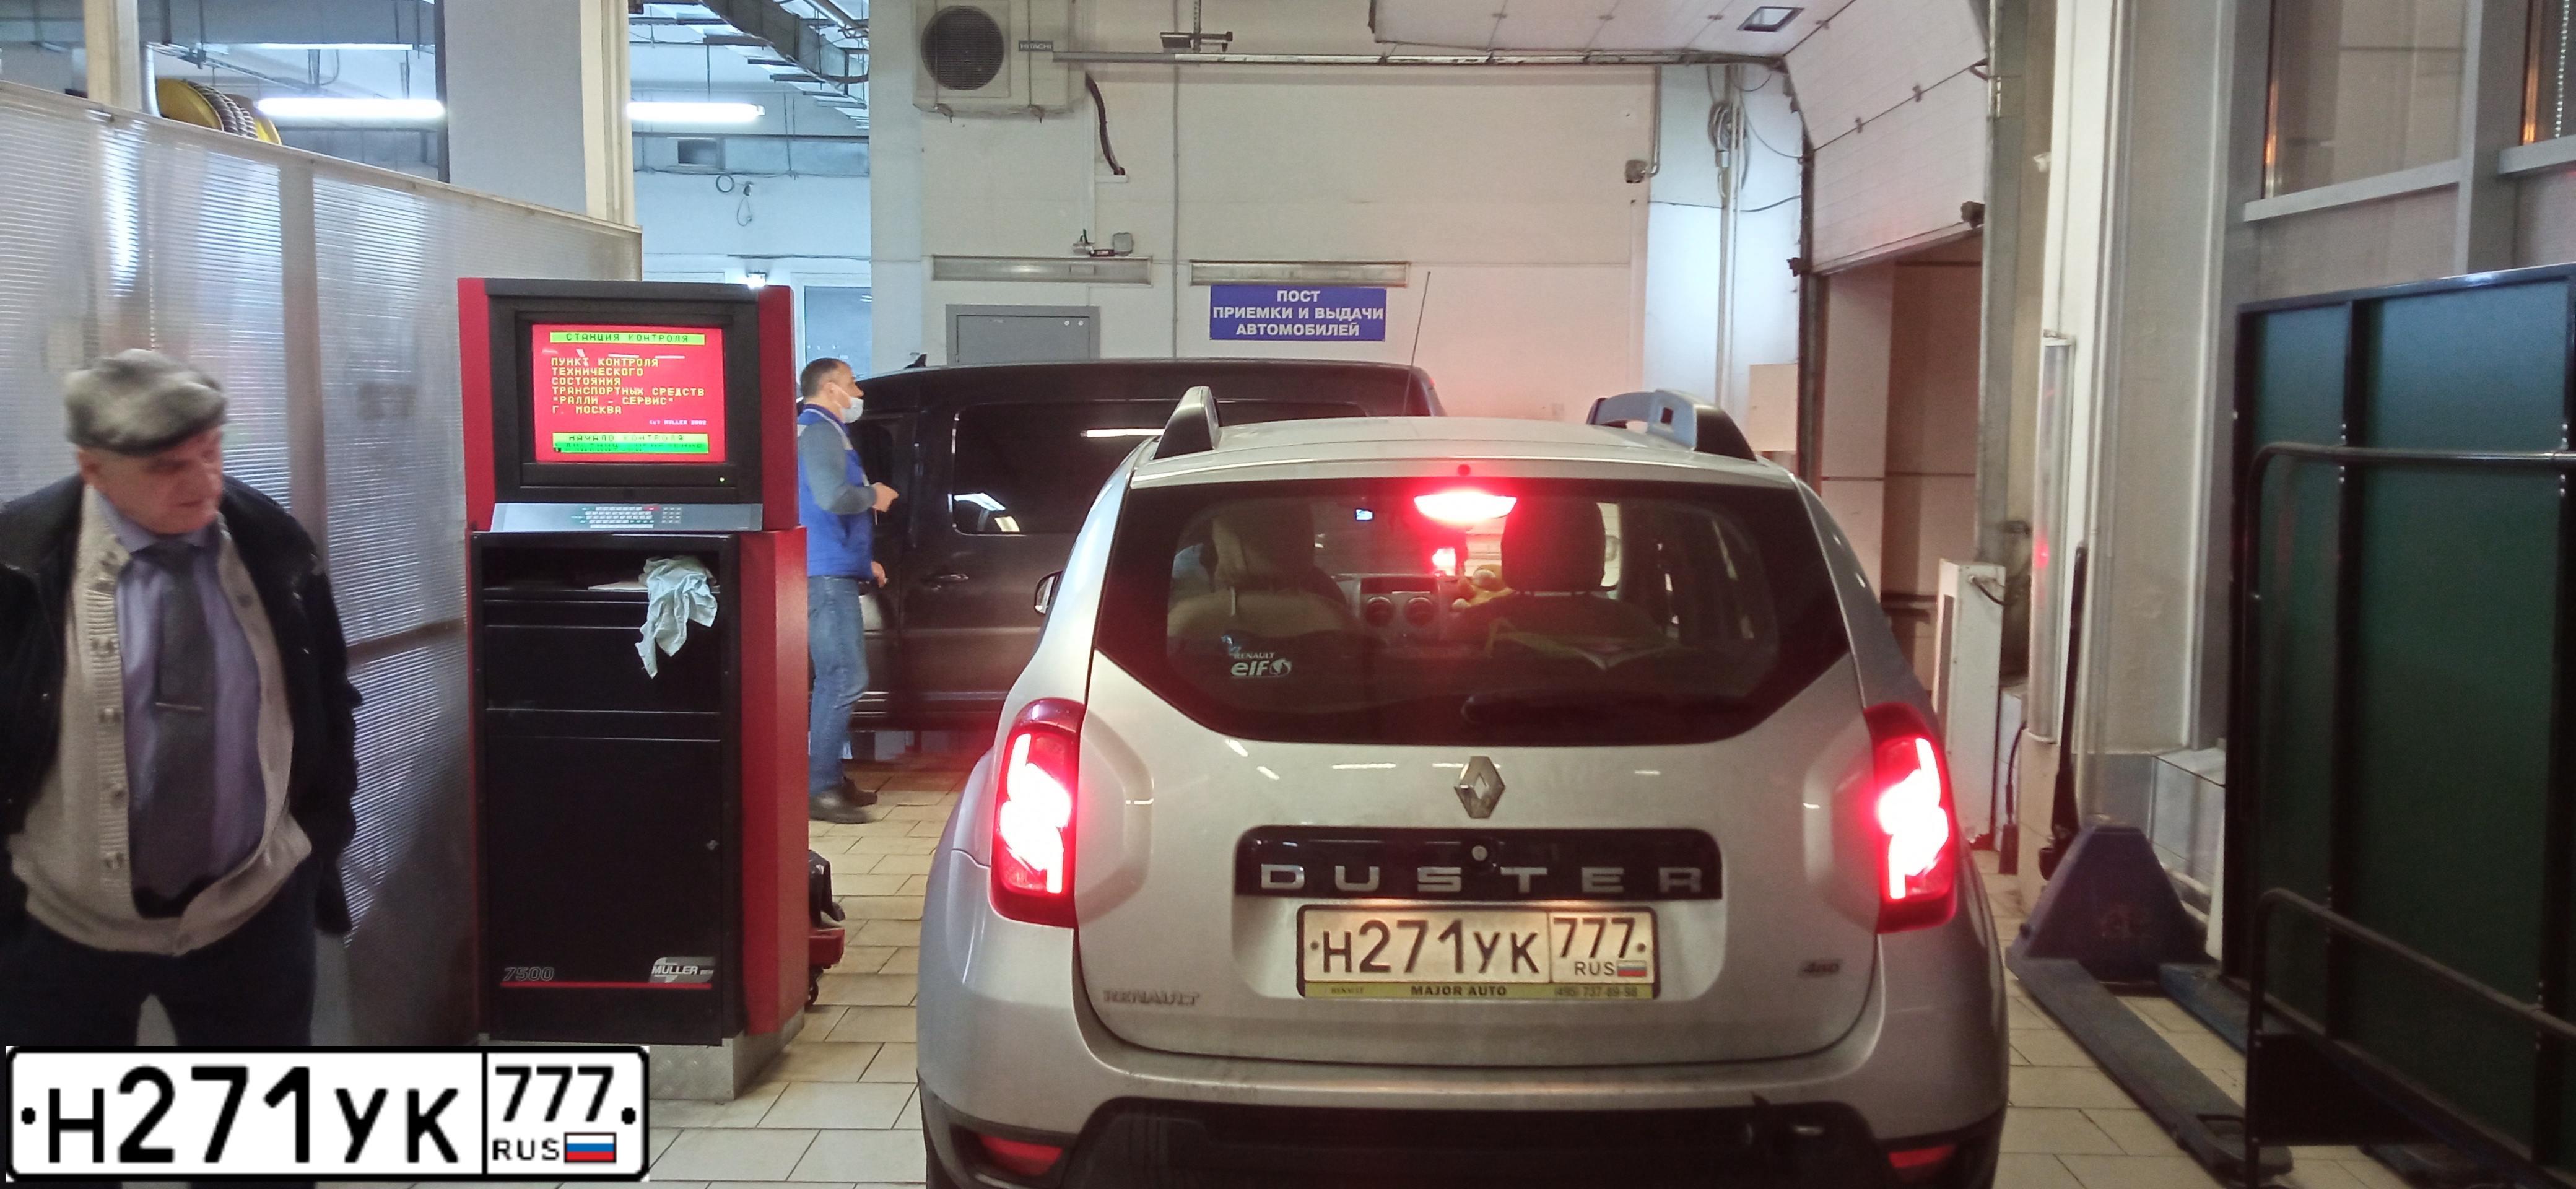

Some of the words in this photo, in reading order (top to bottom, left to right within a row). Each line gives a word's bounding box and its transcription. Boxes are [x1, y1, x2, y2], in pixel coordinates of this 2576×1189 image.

[1277, 290, 1321, 303] ПОСТ
[1213, 307, 1294, 320] ПРИЕМКИ
[1299, 308, 1310, 320] И
[1315, 307, 1383, 322] ВЫДАЧИ
[1236, 322, 1360, 336] АВТОМОБИЛЕЙ
[566, 333, 620, 341] СТАНЦИЯ
[629, 333, 688, 342] КОНТРОЛЯ
[551, 357, 589, 367] ПУНКТ
[598, 358, 659, 367] КОНТРОЛЯ
[552, 367, 644, 377] ТЕХНИЧЕСКОГО
[552, 377, 621, 386] СОСТОЯНИЯ
[552, 386, 644, 396] ТРАНСПОРТНЫХ
[652, 388, 705, 397] СРЕДСТВ
[553, 397, 598, 405] "РАЛЛИ
[622, 397, 674, 406] СЕРВИС"
[575, 406, 622, 414] МОСКВА
[1230, 660, 1269, 676] elf
[1260, 864, 1703, 894] DUSTER
[1553, 917, 1635, 959] 777
[503, 967, 555, 982] 7500
[651, 965, 698, 975] MULLER
[1574, 961, 1615, 977] RUS
[1411, 986, 1463, 996] MAJOR
[1468, 986, 1507, 996] AUTO
[1103, 990, 1200, 1005] RENAULT
